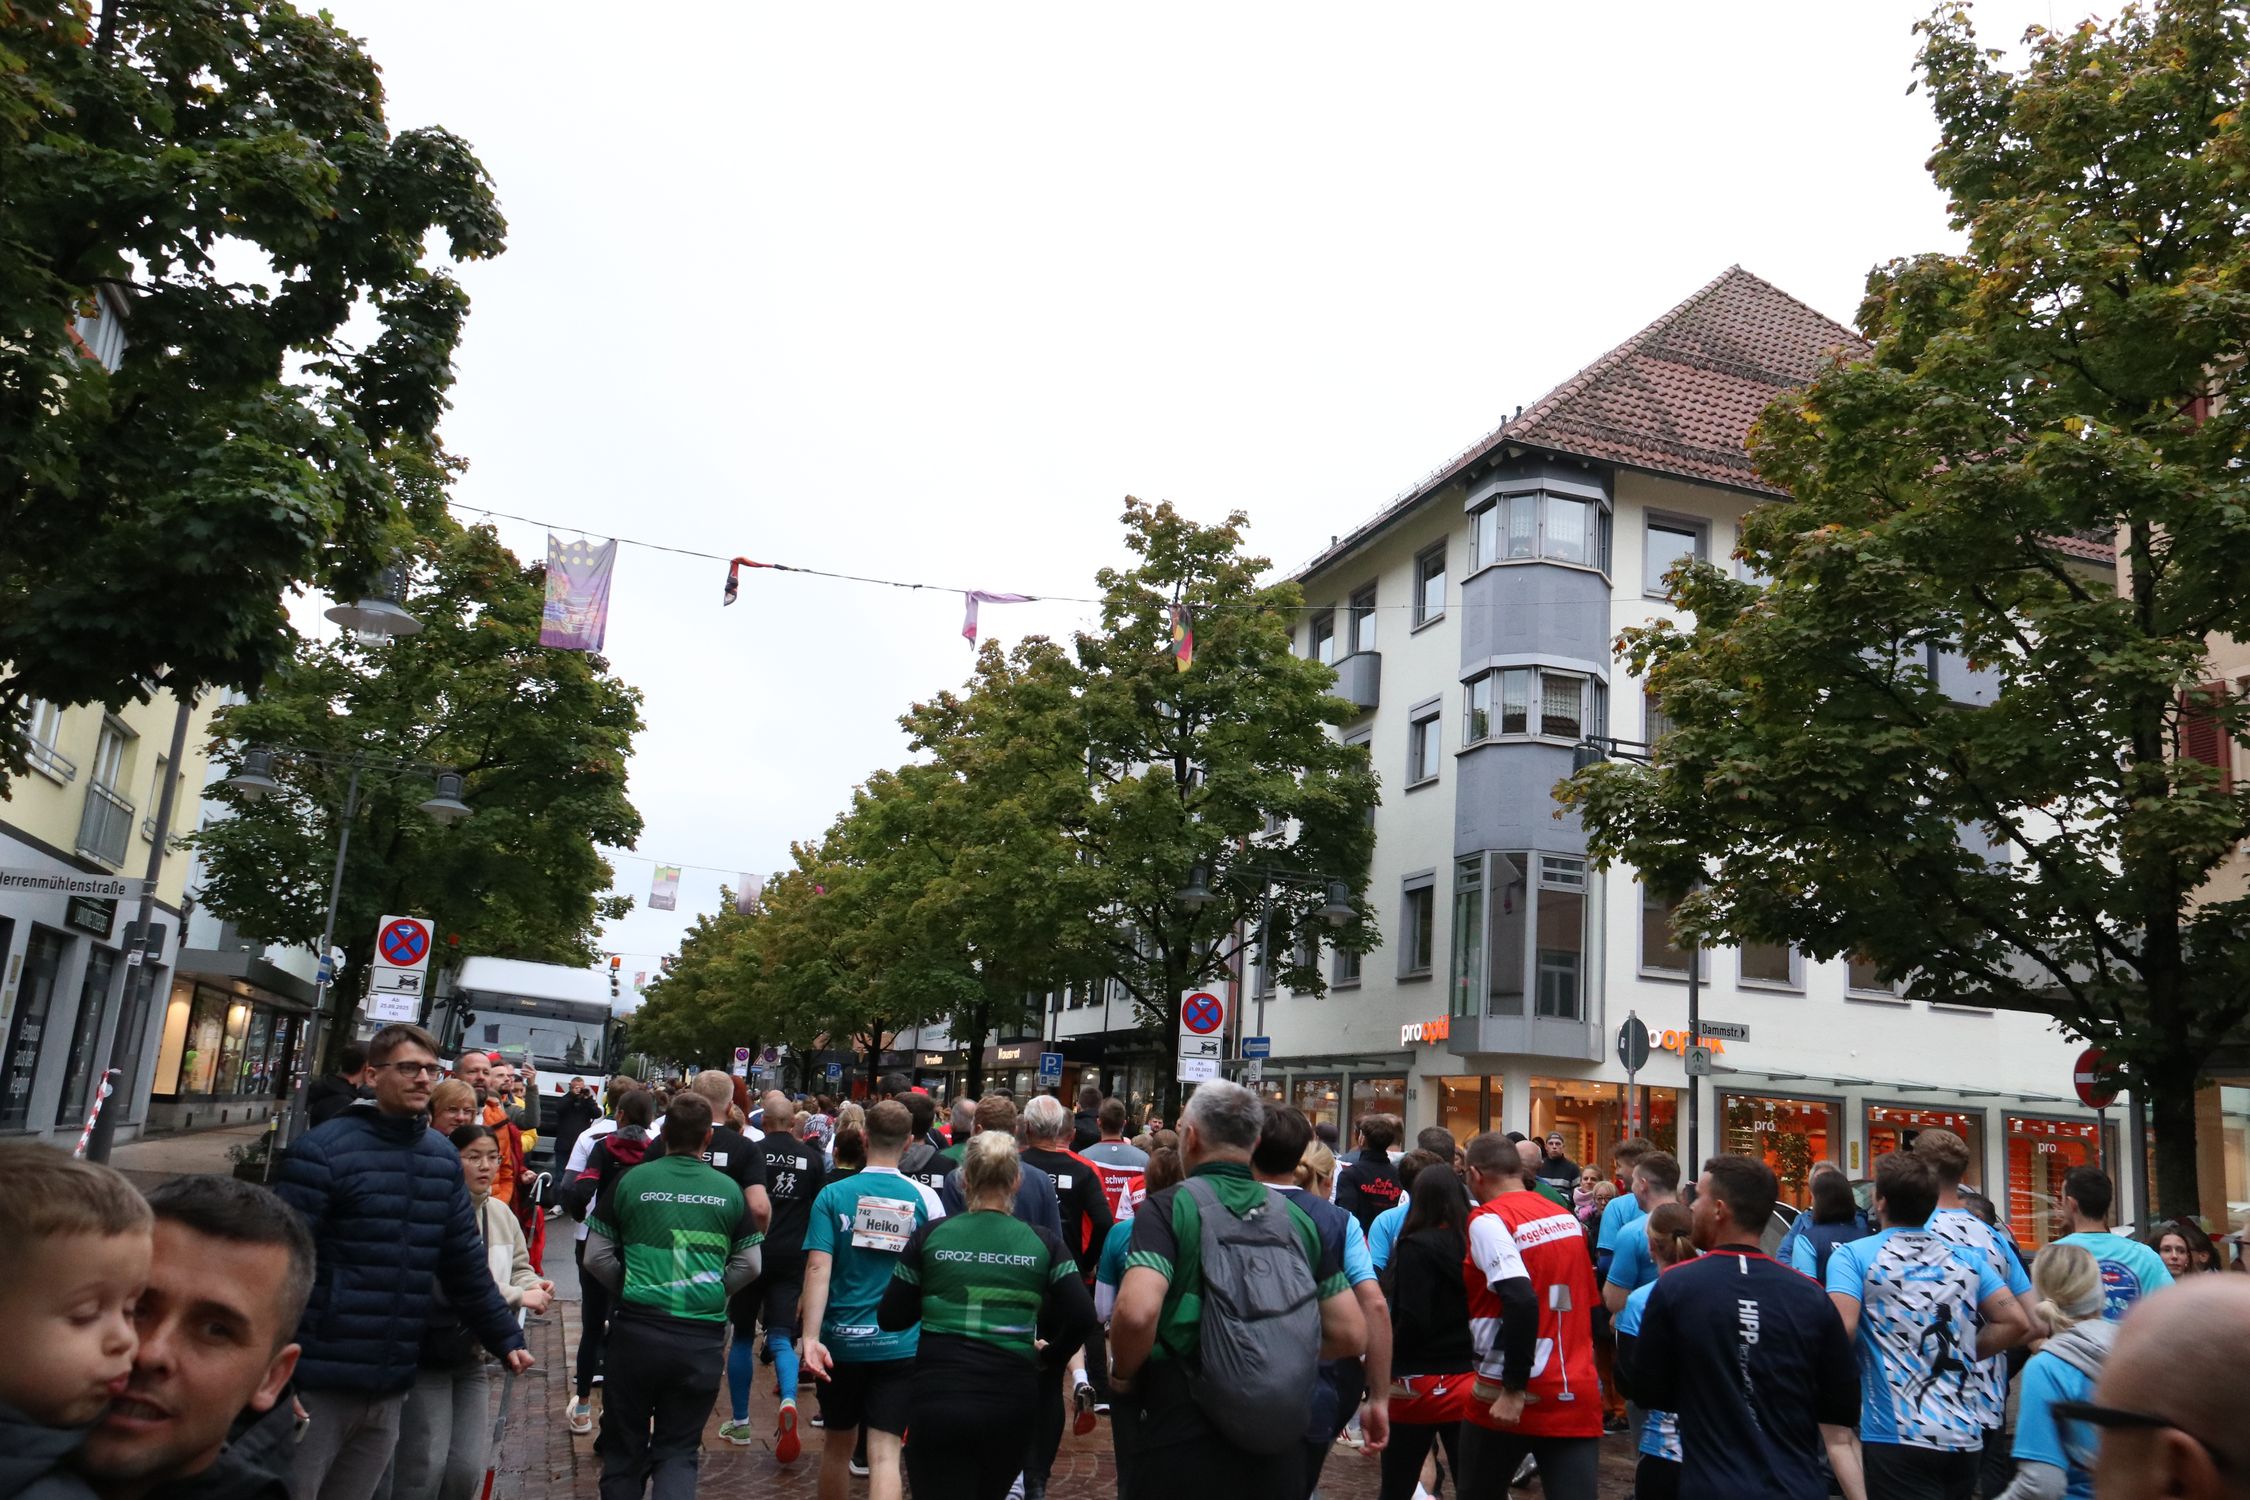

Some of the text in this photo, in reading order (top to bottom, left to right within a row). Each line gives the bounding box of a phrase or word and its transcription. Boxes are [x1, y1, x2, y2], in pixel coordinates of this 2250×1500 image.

[1702, 1023, 1739, 1038] Dammstr.
[766, 1153, 796, 1165] DAS
[640, 1192, 727, 1207] GROZ-BECKERT
[859, 1208, 872, 1216] 742
[866, 1218, 899, 1233] Heiko
[888, 1243, 901, 1251] 742
[934, 1249, 1038, 1267] GROZ-BECKERT
[1738, 1299, 1760, 1345] HIPP
